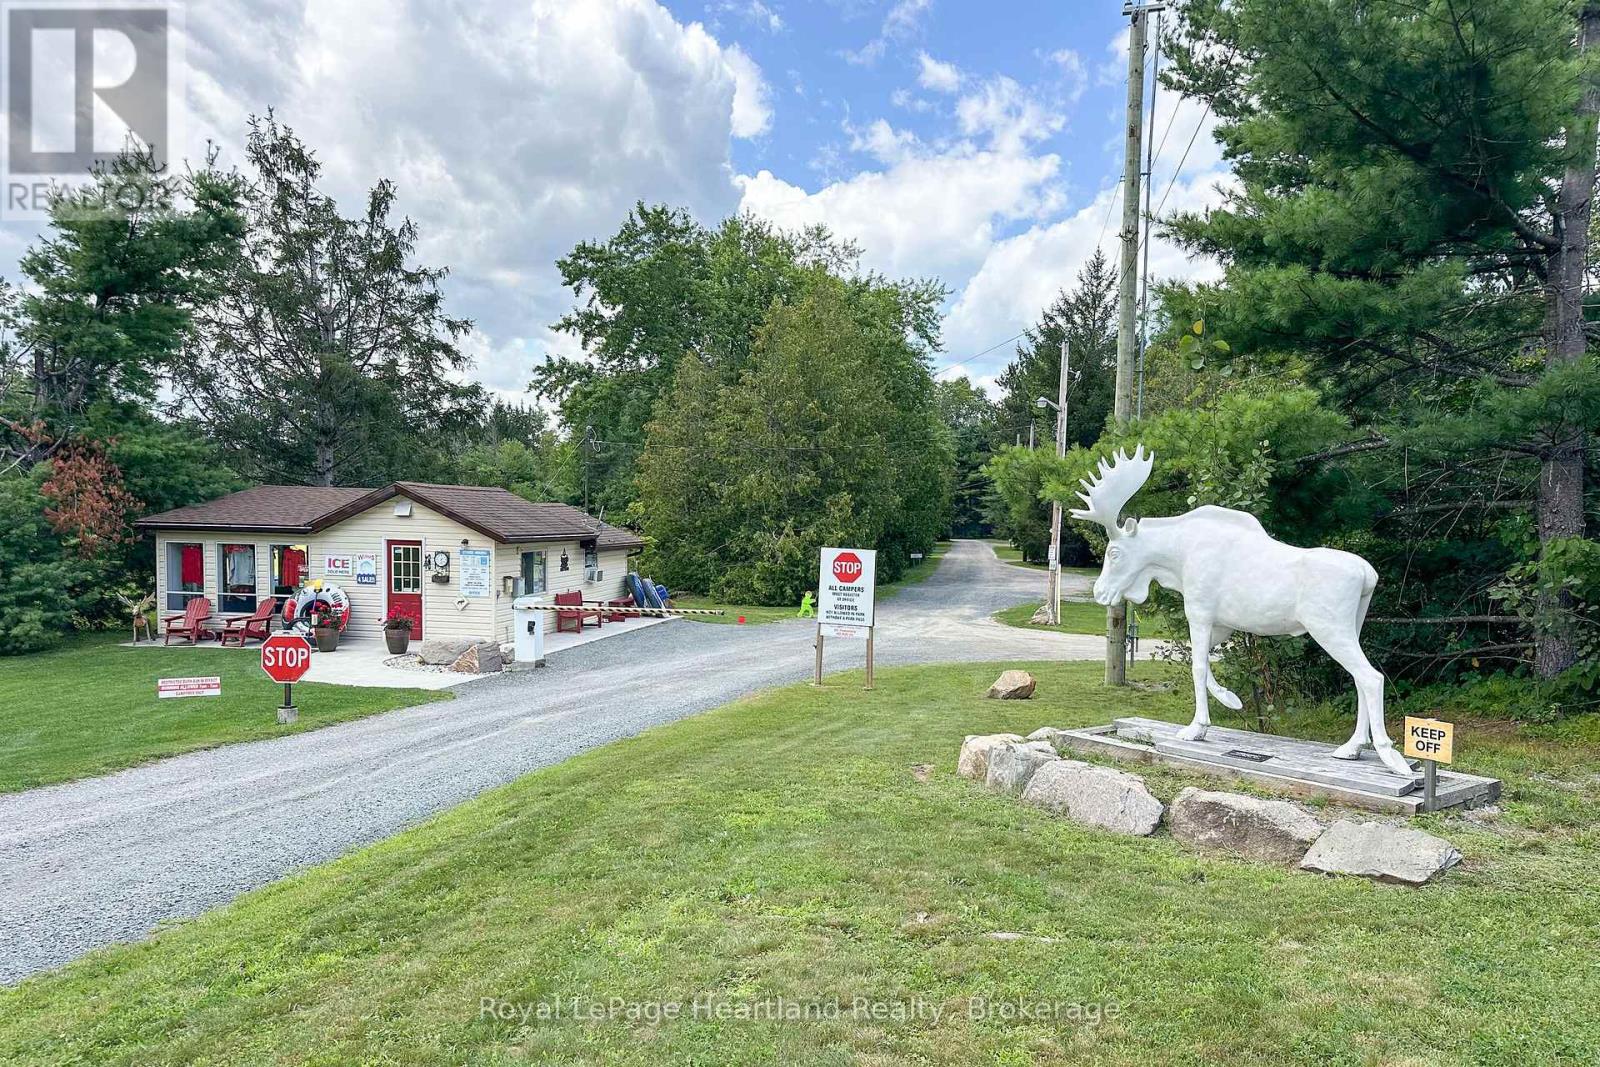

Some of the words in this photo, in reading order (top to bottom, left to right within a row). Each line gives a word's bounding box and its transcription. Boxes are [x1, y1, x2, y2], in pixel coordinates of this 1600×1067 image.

[328, 558, 350, 569] ICE
[834, 561, 861, 574] STOP
[834, 604, 858, 612] VISITORS
[264, 646, 309, 668] STOP
[1411, 726, 1446, 741] KEEP
[1415, 740, 1441, 754] OFF
